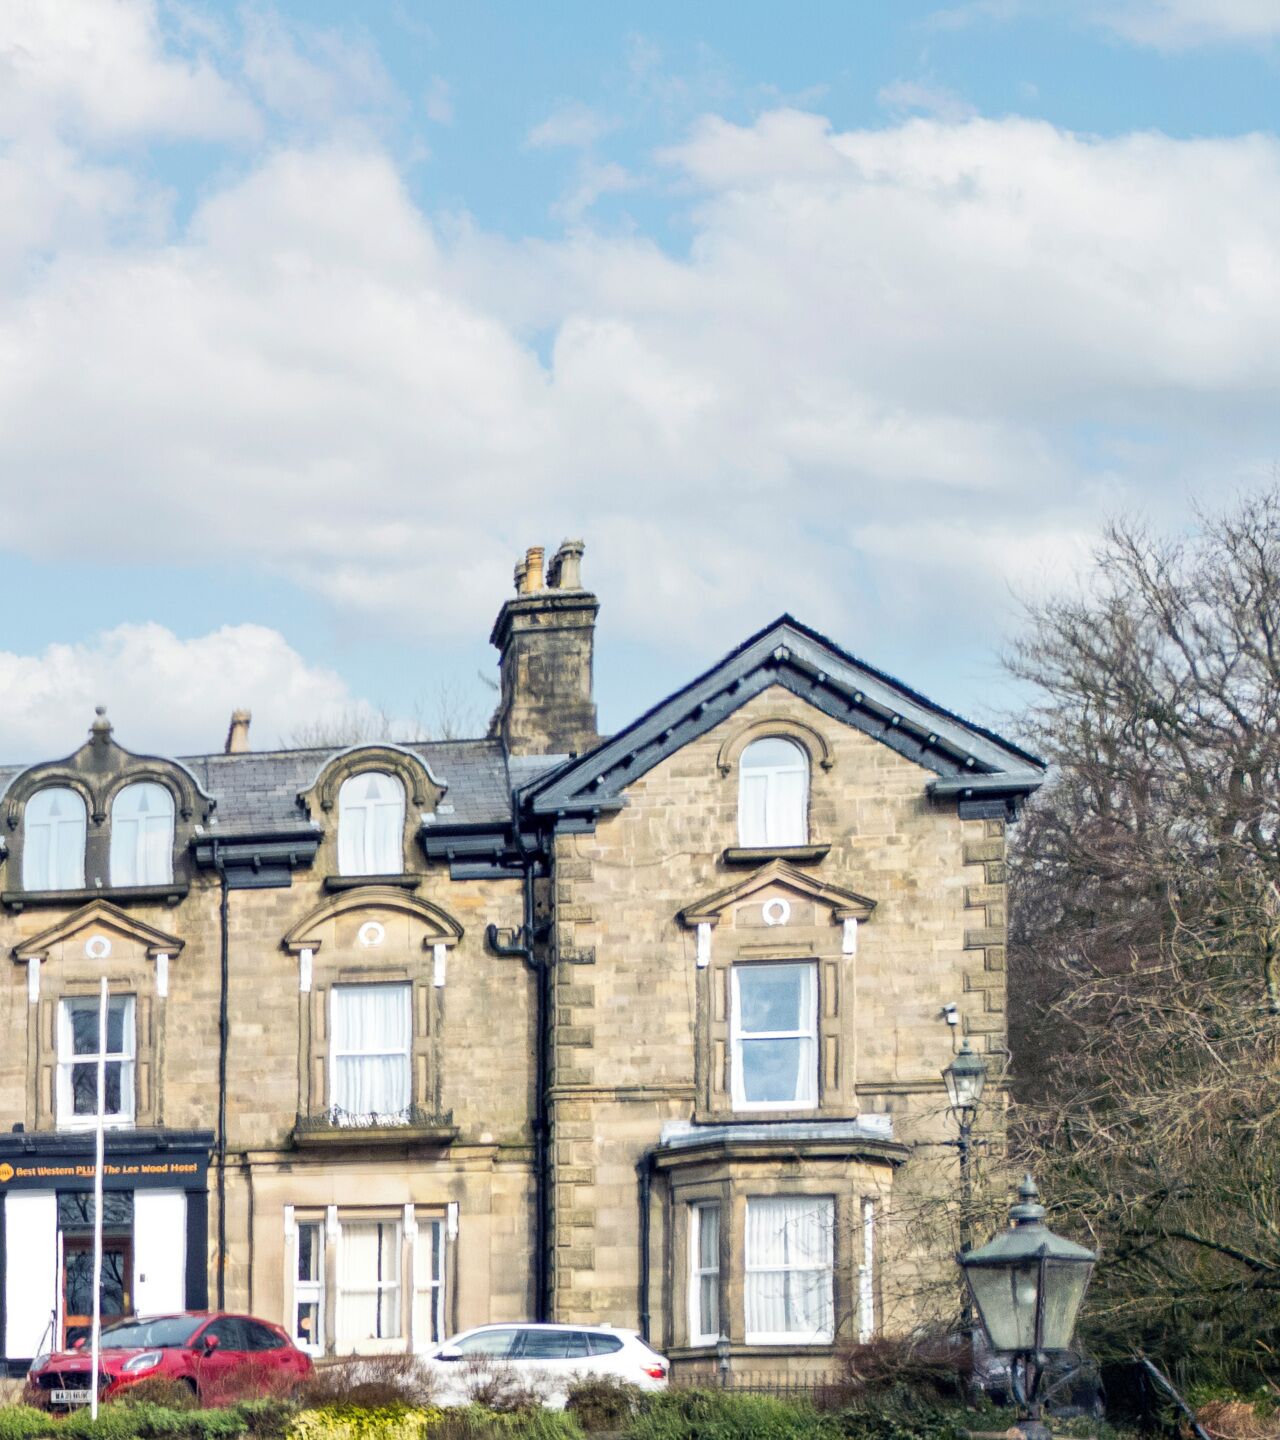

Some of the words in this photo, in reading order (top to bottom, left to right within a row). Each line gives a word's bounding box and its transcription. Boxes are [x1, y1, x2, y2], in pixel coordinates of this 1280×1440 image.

[16, 1166, 36, 1177] Best
[37, 1165, 75, 1176] Western
[75, 1165, 96, 1176] PLU
[103, 1164, 120, 1174] The
[122, 1164, 139, 1174] Lee
[141, 1163, 168, 1173] Wood
[170, 1162, 198, 1173] Hotel
